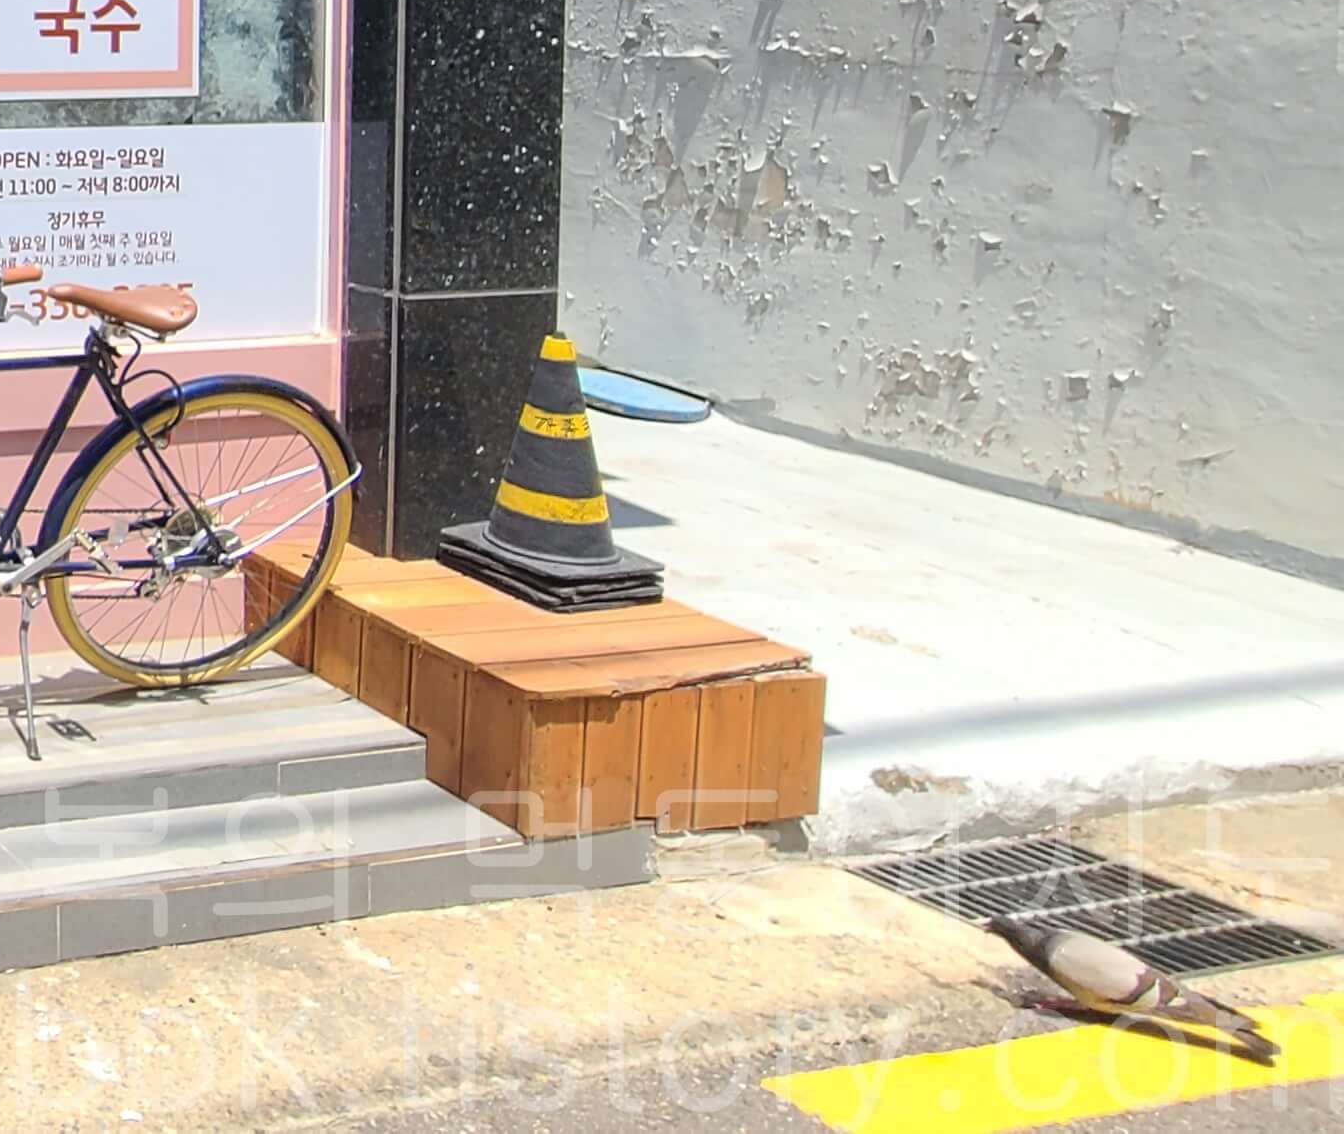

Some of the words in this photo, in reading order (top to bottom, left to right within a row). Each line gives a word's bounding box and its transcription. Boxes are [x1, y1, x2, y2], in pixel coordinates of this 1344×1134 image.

[8, 178, 56, 195] 11:00
[77, 176, 108, 196] 저녁
[112, 174, 180, 193] 8:00까지
[47, 210, 106, 231] 정기휴무
[8, 235, 46, 252] 월요일
[59, 233, 85, 251] 매월
[90, 233, 115, 250] 첫째
[120, 232, 131, 248] 주
[135, 230, 172, 248] 일요일
[58, 253, 101, 268] 조기마감
[119, 253, 130, 265] 수
